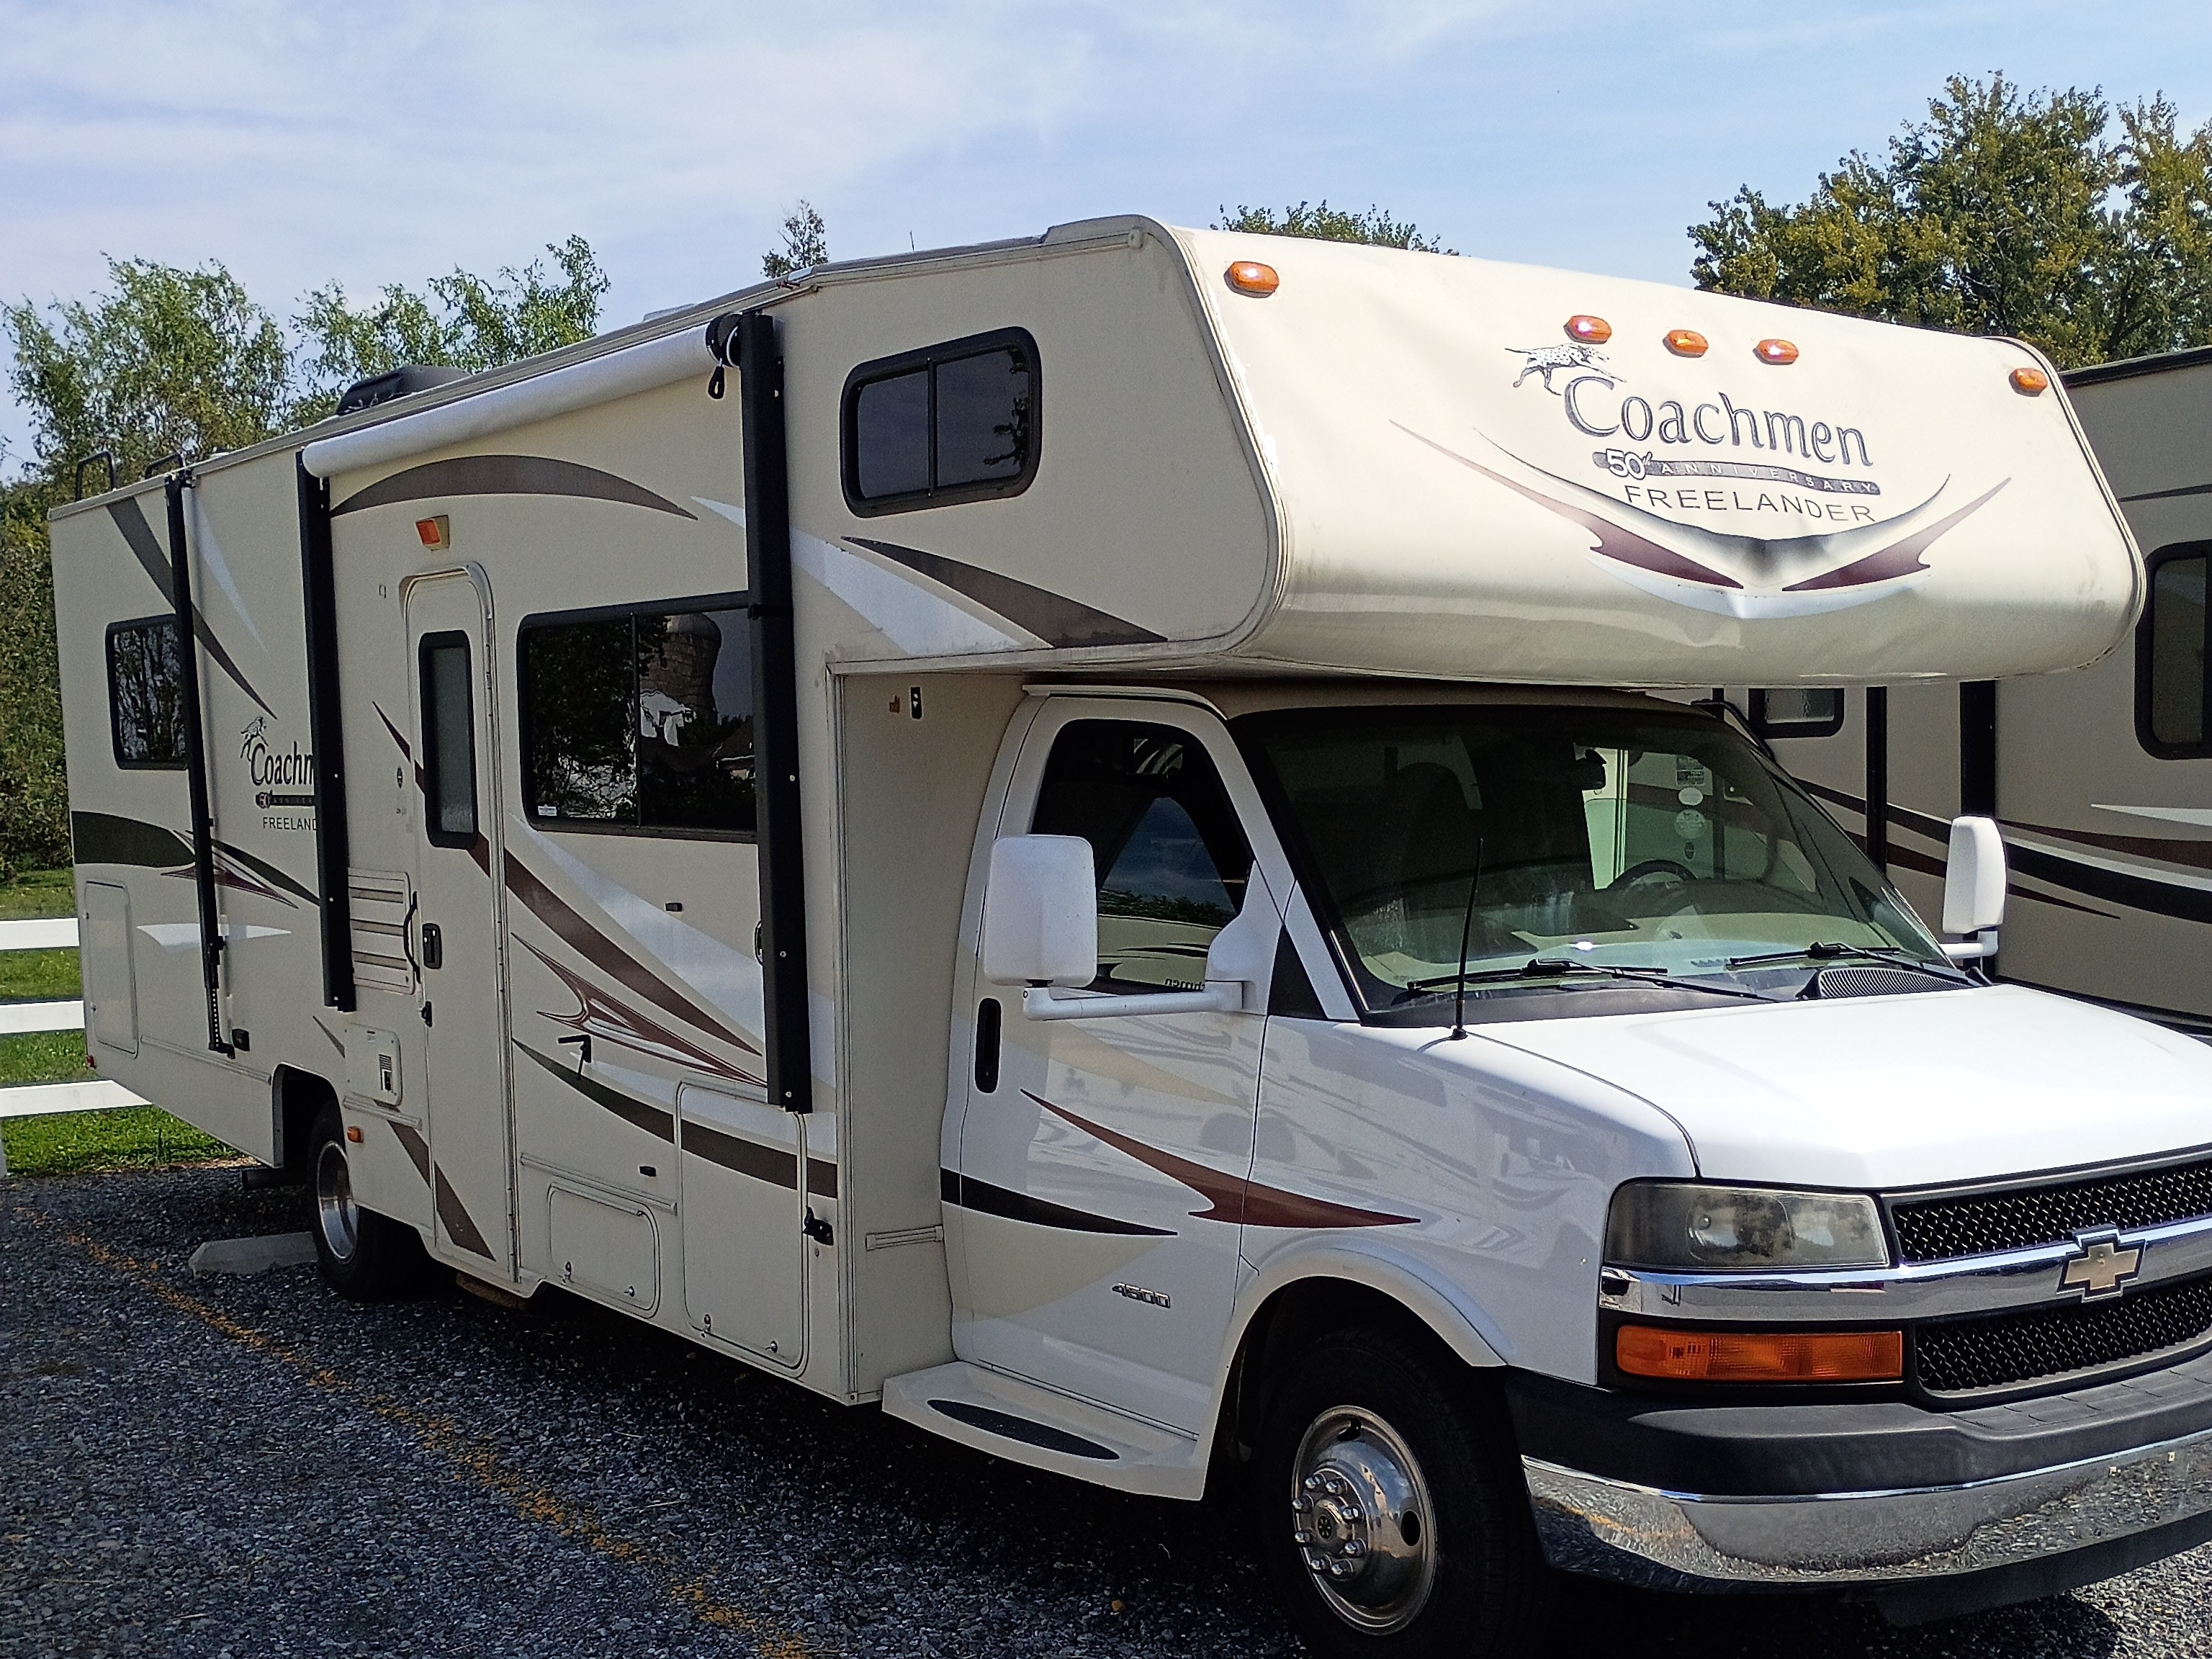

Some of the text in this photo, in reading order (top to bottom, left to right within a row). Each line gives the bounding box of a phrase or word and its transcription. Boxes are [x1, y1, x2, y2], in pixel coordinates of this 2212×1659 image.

[1564, 376, 1874, 467] Coachmen
[1661, 462, 1872, 493] ANNIVERSARY
[1624, 485, 1876, 522] FREELANDER
[1112, 1282, 1171, 1308] 4500
